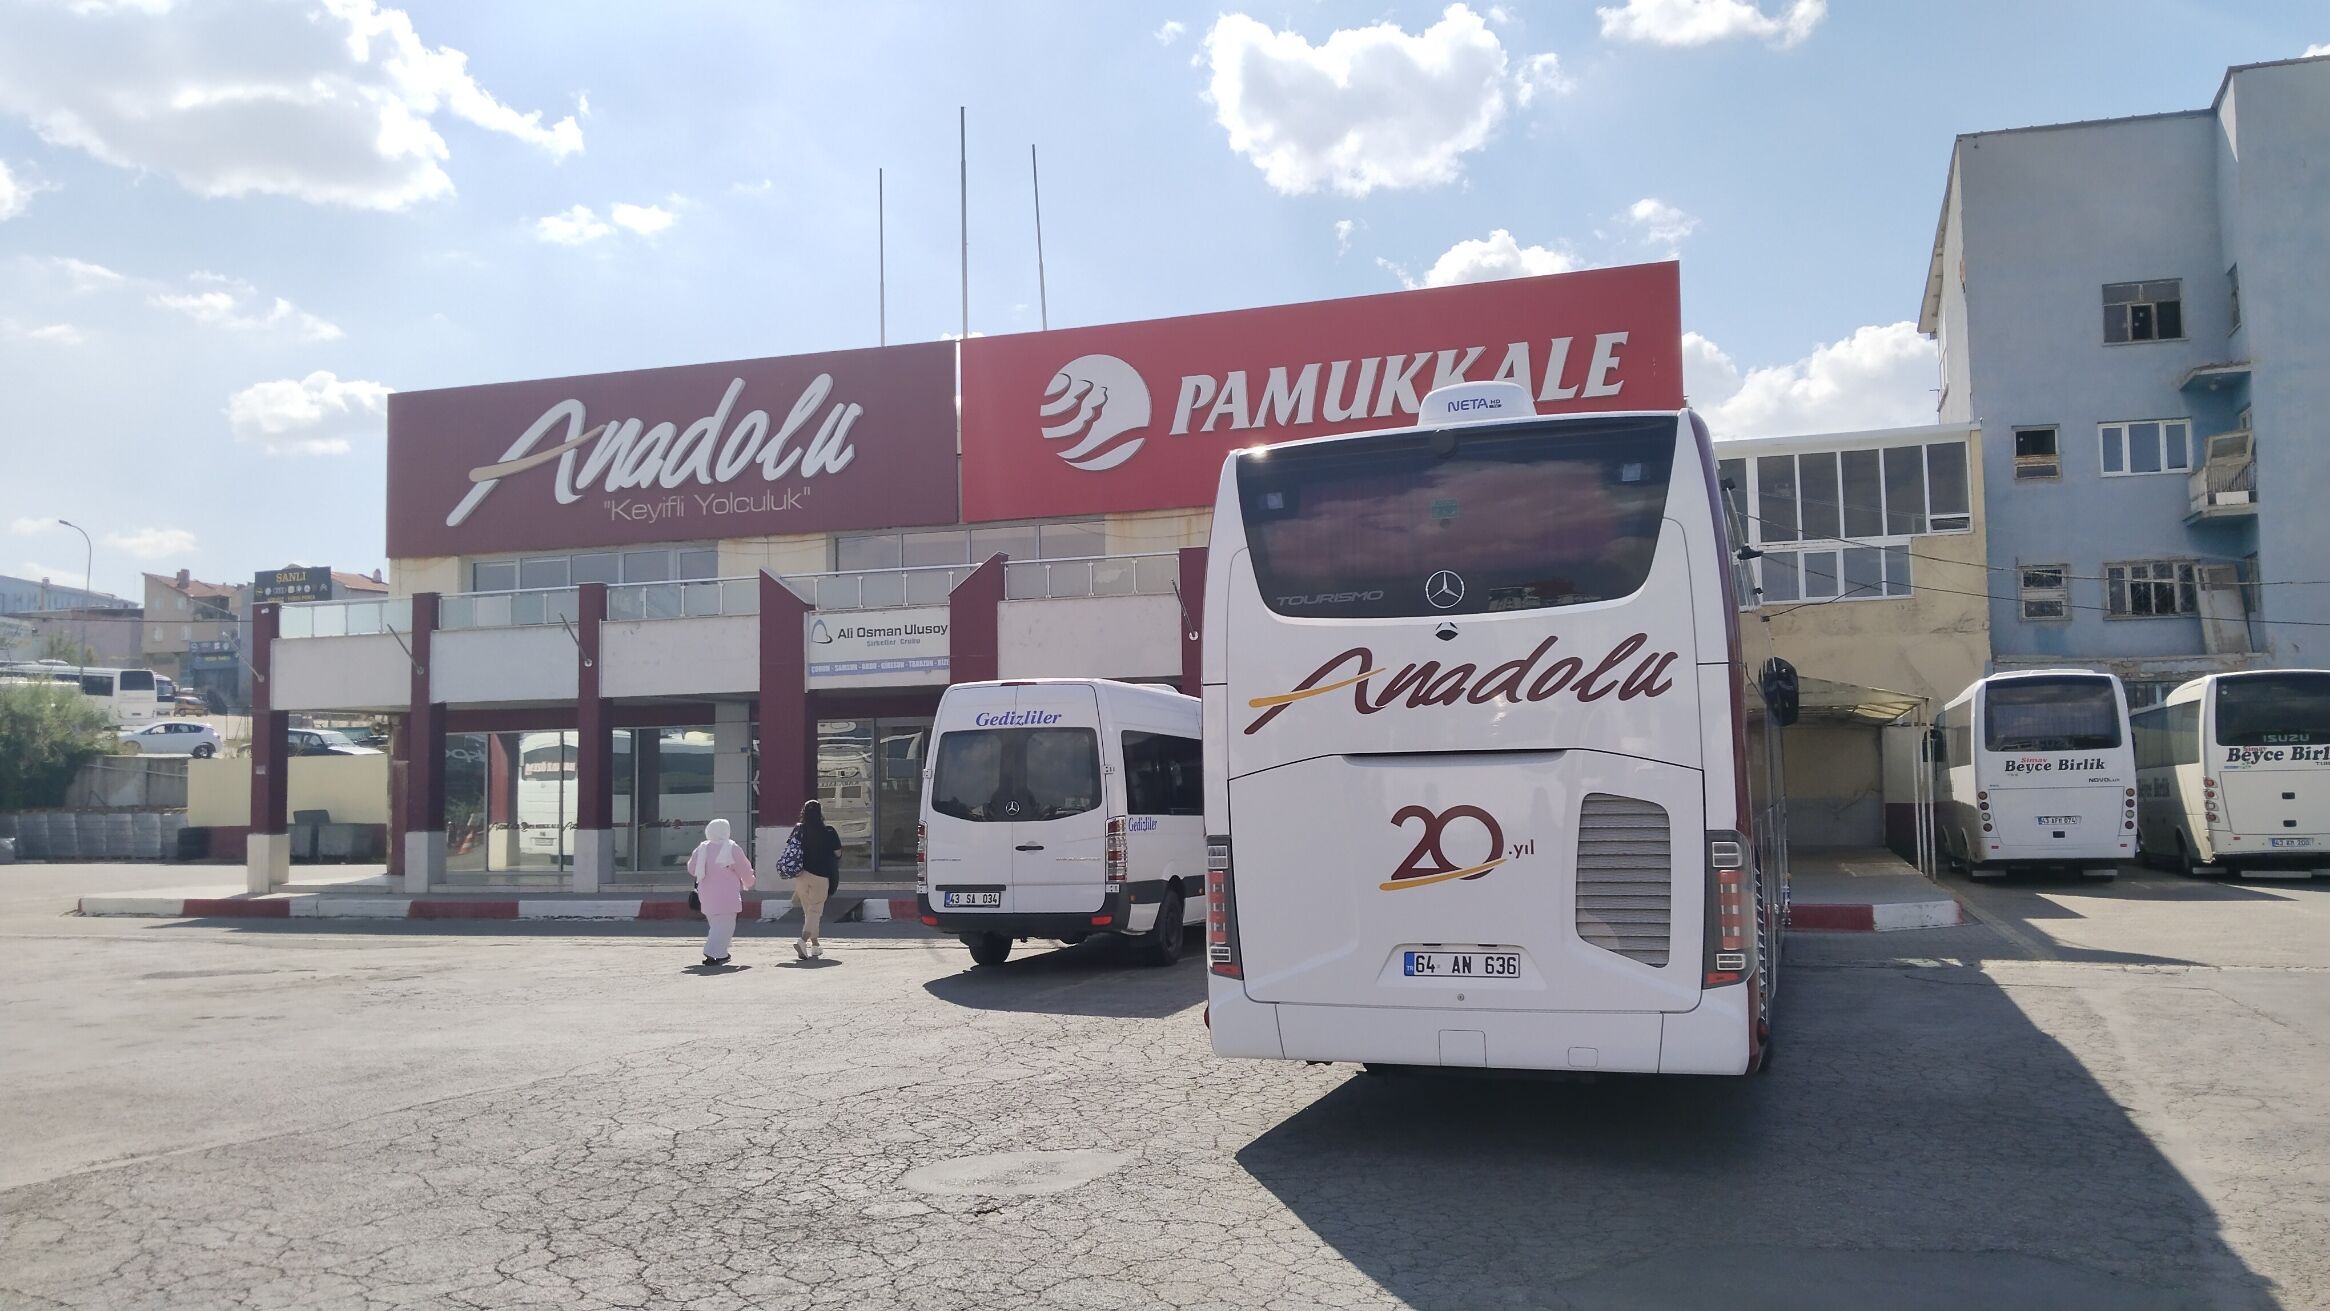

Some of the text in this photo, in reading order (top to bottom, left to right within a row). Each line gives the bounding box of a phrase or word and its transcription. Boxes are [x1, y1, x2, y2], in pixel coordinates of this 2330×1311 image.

[1169, 331, 1629, 435] PAMUKKALE
[1447, 398, 1488, 412] NETA
[446, 373, 863, 527] Anadolu
[604, 486, 811, 524] "Keyifli Yolculuk"
[1276, 590, 1384, 606] TOURISMO
[838, 624, 949, 639] Ali Osman Ulusoy
[1244, 633, 1679, 735] Anadolu
[976, 710, 1062, 727] Gedizliler
[2263, 734, 2310, 743] ISUZU
[2226, 747, 2284, 764] Beyce
[2005, 758, 2105, 774] Beyce Birlik
[1128, 816, 1157, 832] Gedizliler
[1391, 804, 1504, 880] 20
[950, 893, 998, 904] 43 SA 034
[1415, 955, 1435, 973] 64
[1452, 955, 1472, 974] AN
[1485, 956, 1517, 975] 636
